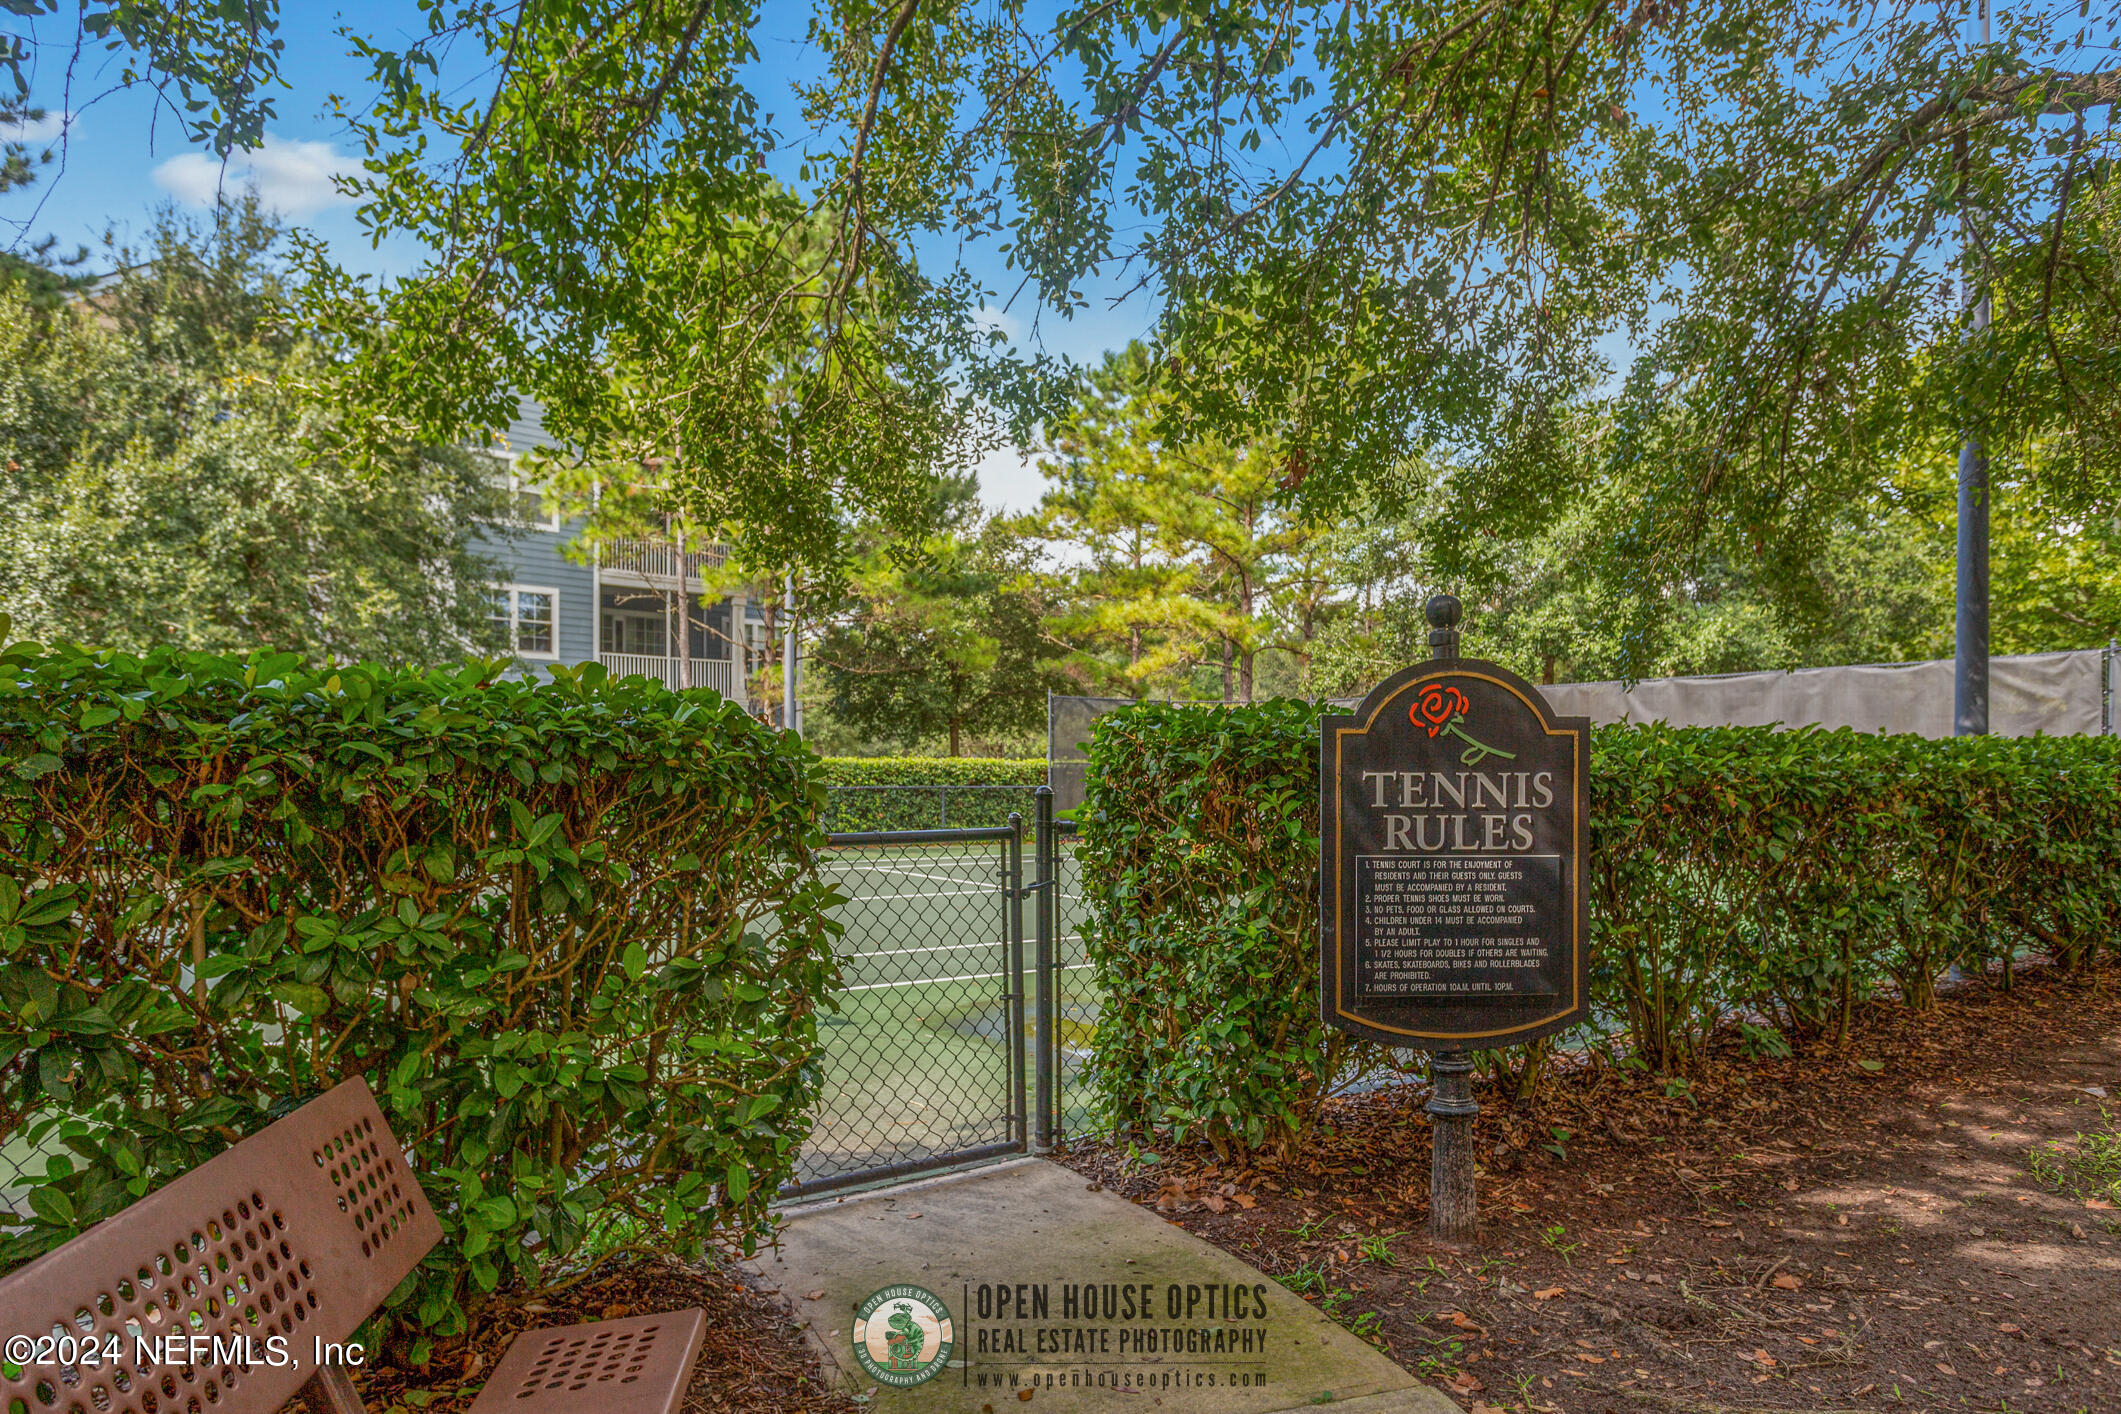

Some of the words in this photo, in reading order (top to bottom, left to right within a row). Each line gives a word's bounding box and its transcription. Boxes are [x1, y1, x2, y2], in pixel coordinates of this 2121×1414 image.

[1362, 771, 1553, 808] TENNIS
[1383, 814, 1534, 851] RULES
[1375, 872, 1410, 880] RESIDENTS
[1413, 872, 1426, 880] AND
[1430, 872, 1449, 880] THEIR
[1451, 872, 1476, 880] GUESTS
[1456, 883, 1464, 891] BY
[1467, 883, 1472, 891] A
[1475, 883, 1507, 891] RESIDENT.
[1452, 894, 1470, 902] MUST
[1464, 905, 1493, 913] ALLOWED
[1497, 905, 1505, 913] ON
[1508, 905, 1535, 913] COURTS.
[1478, 916, 1522, 924] ACCOMPANIED
[1461, 938, 1479, 946] HOUR
[1482, 938, 1494, 946] FOR
[1498, 938, 1523, 946] SINGLES
[1469, 949, 1474, 957] IF
[1453, 960, 1472, 968] BIKES
[1474, 960, 1487, 968] AND
[1490, 960, 1540, 968] ROLLERBLADES
[1365, 984, 1371, 992] 7.
[1374, 984, 1396, 992] HOURS
[1472, 983, 1491, 991] UNTIL
